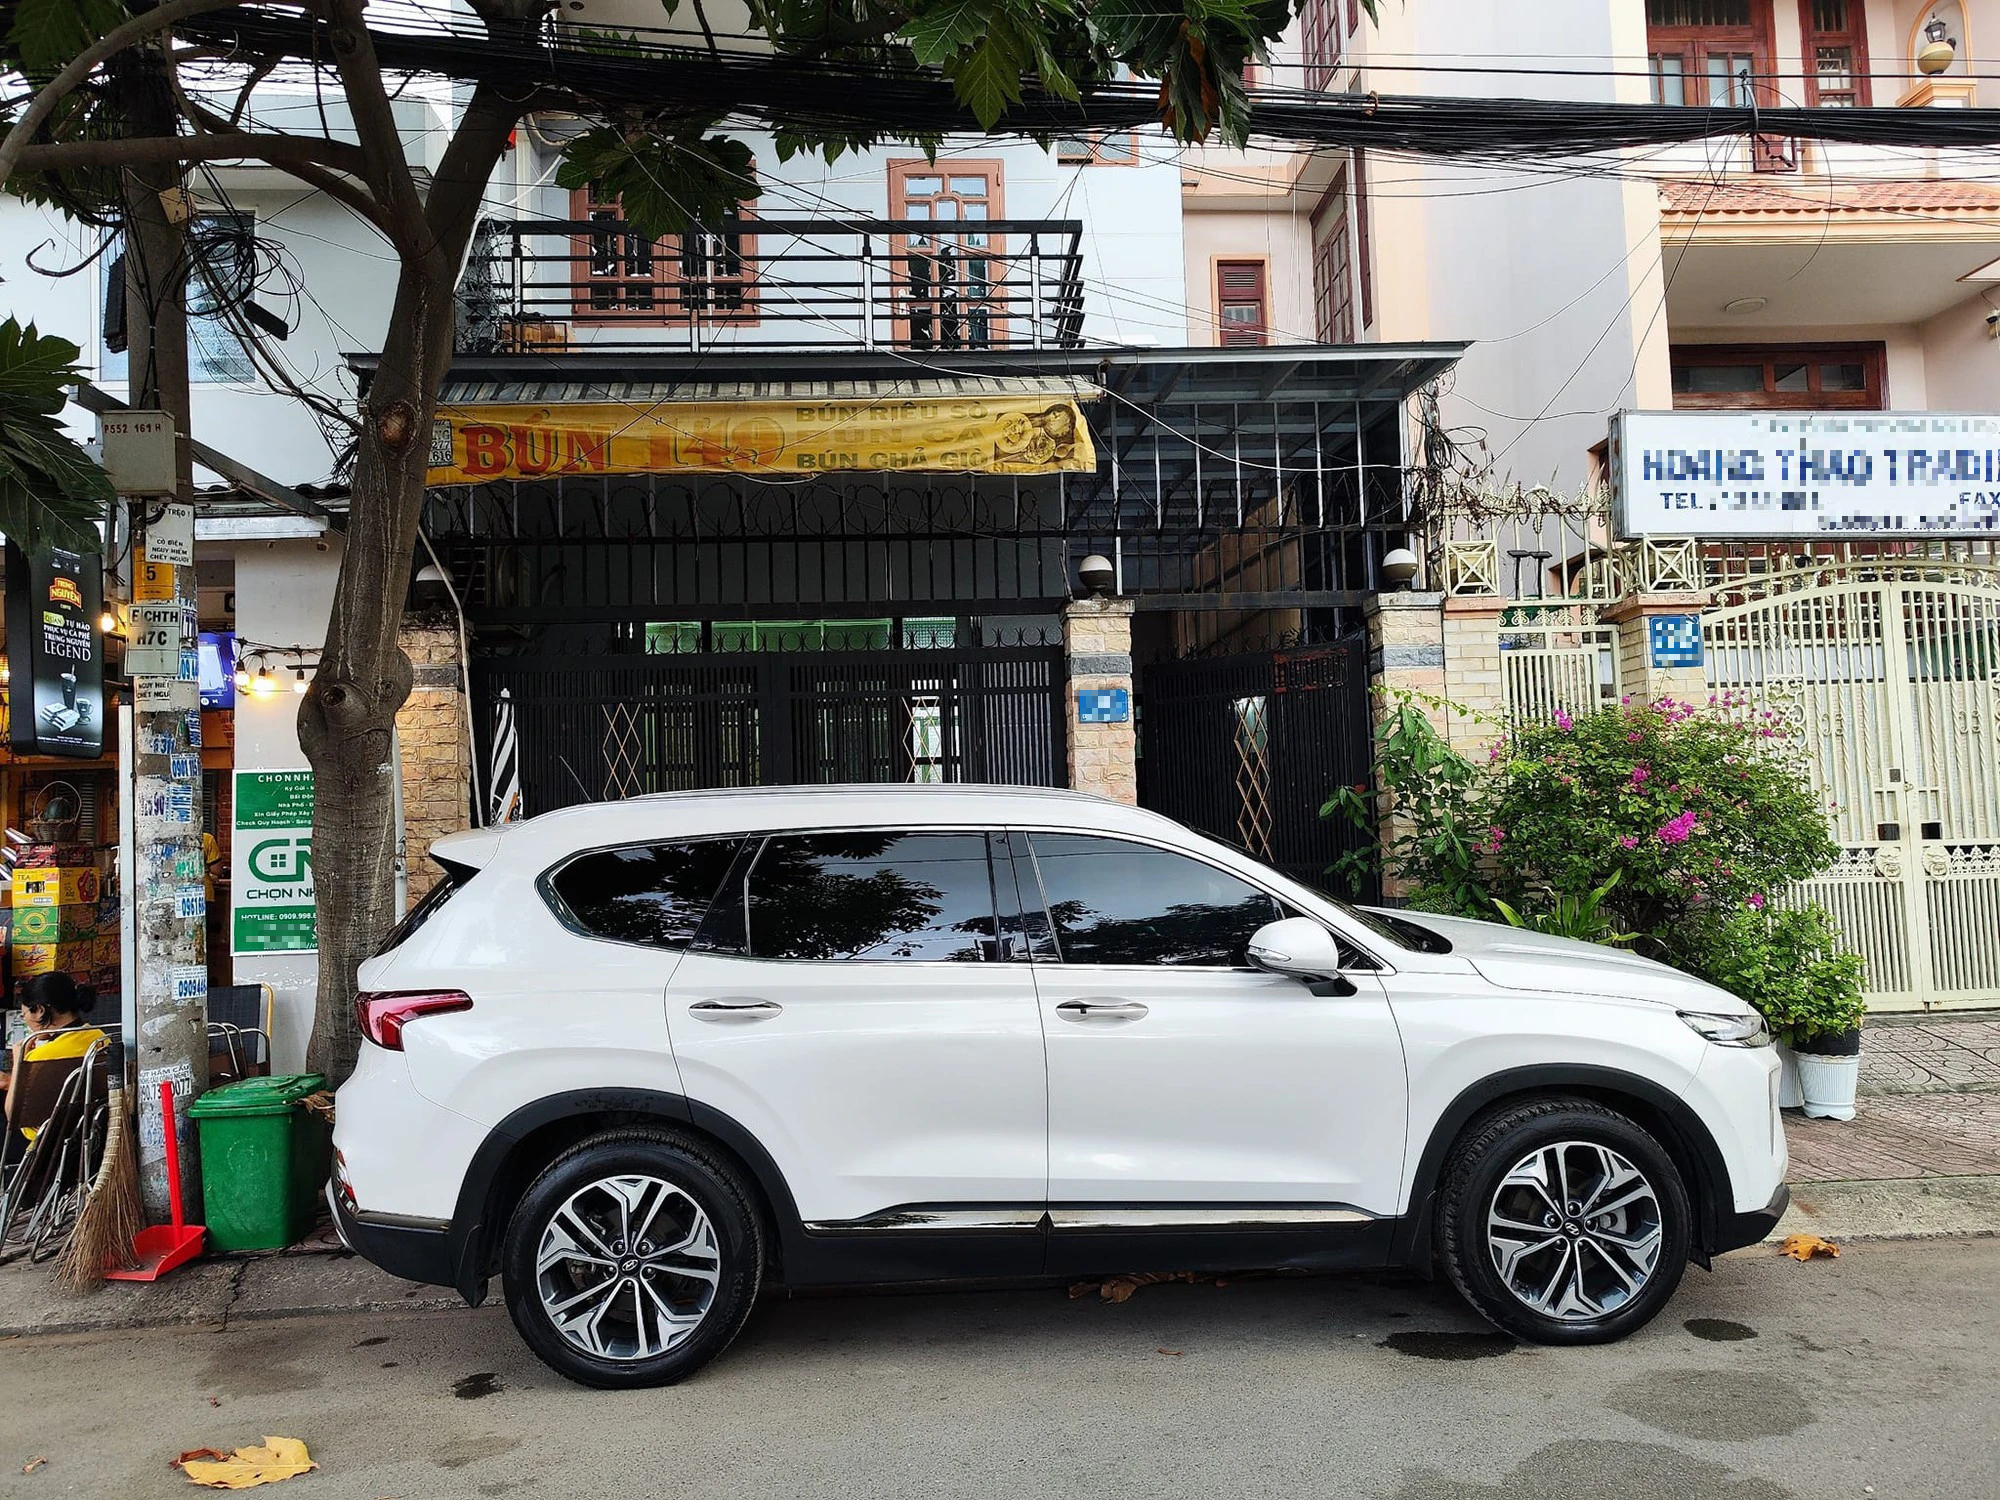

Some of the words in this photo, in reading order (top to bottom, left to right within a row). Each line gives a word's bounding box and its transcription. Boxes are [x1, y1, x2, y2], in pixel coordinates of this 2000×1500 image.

[798, 403, 858, 422] BÚN
[870, 402, 938, 421] RIÊU
[104, 424, 128, 434] P552
[135, 424, 152, 433] 161
[460, 409, 615, 475] BÚN
[797, 450, 858, 469] BÚN
[868, 447, 928, 468] CHẢ
[146, 566, 156, 581] 5
[144, 611, 179, 622] CHTH
[44, 640, 91, 661] LEGEND
[257, 774, 314, 782] CHONNH
[247, 889, 293, 901] CHỌN
